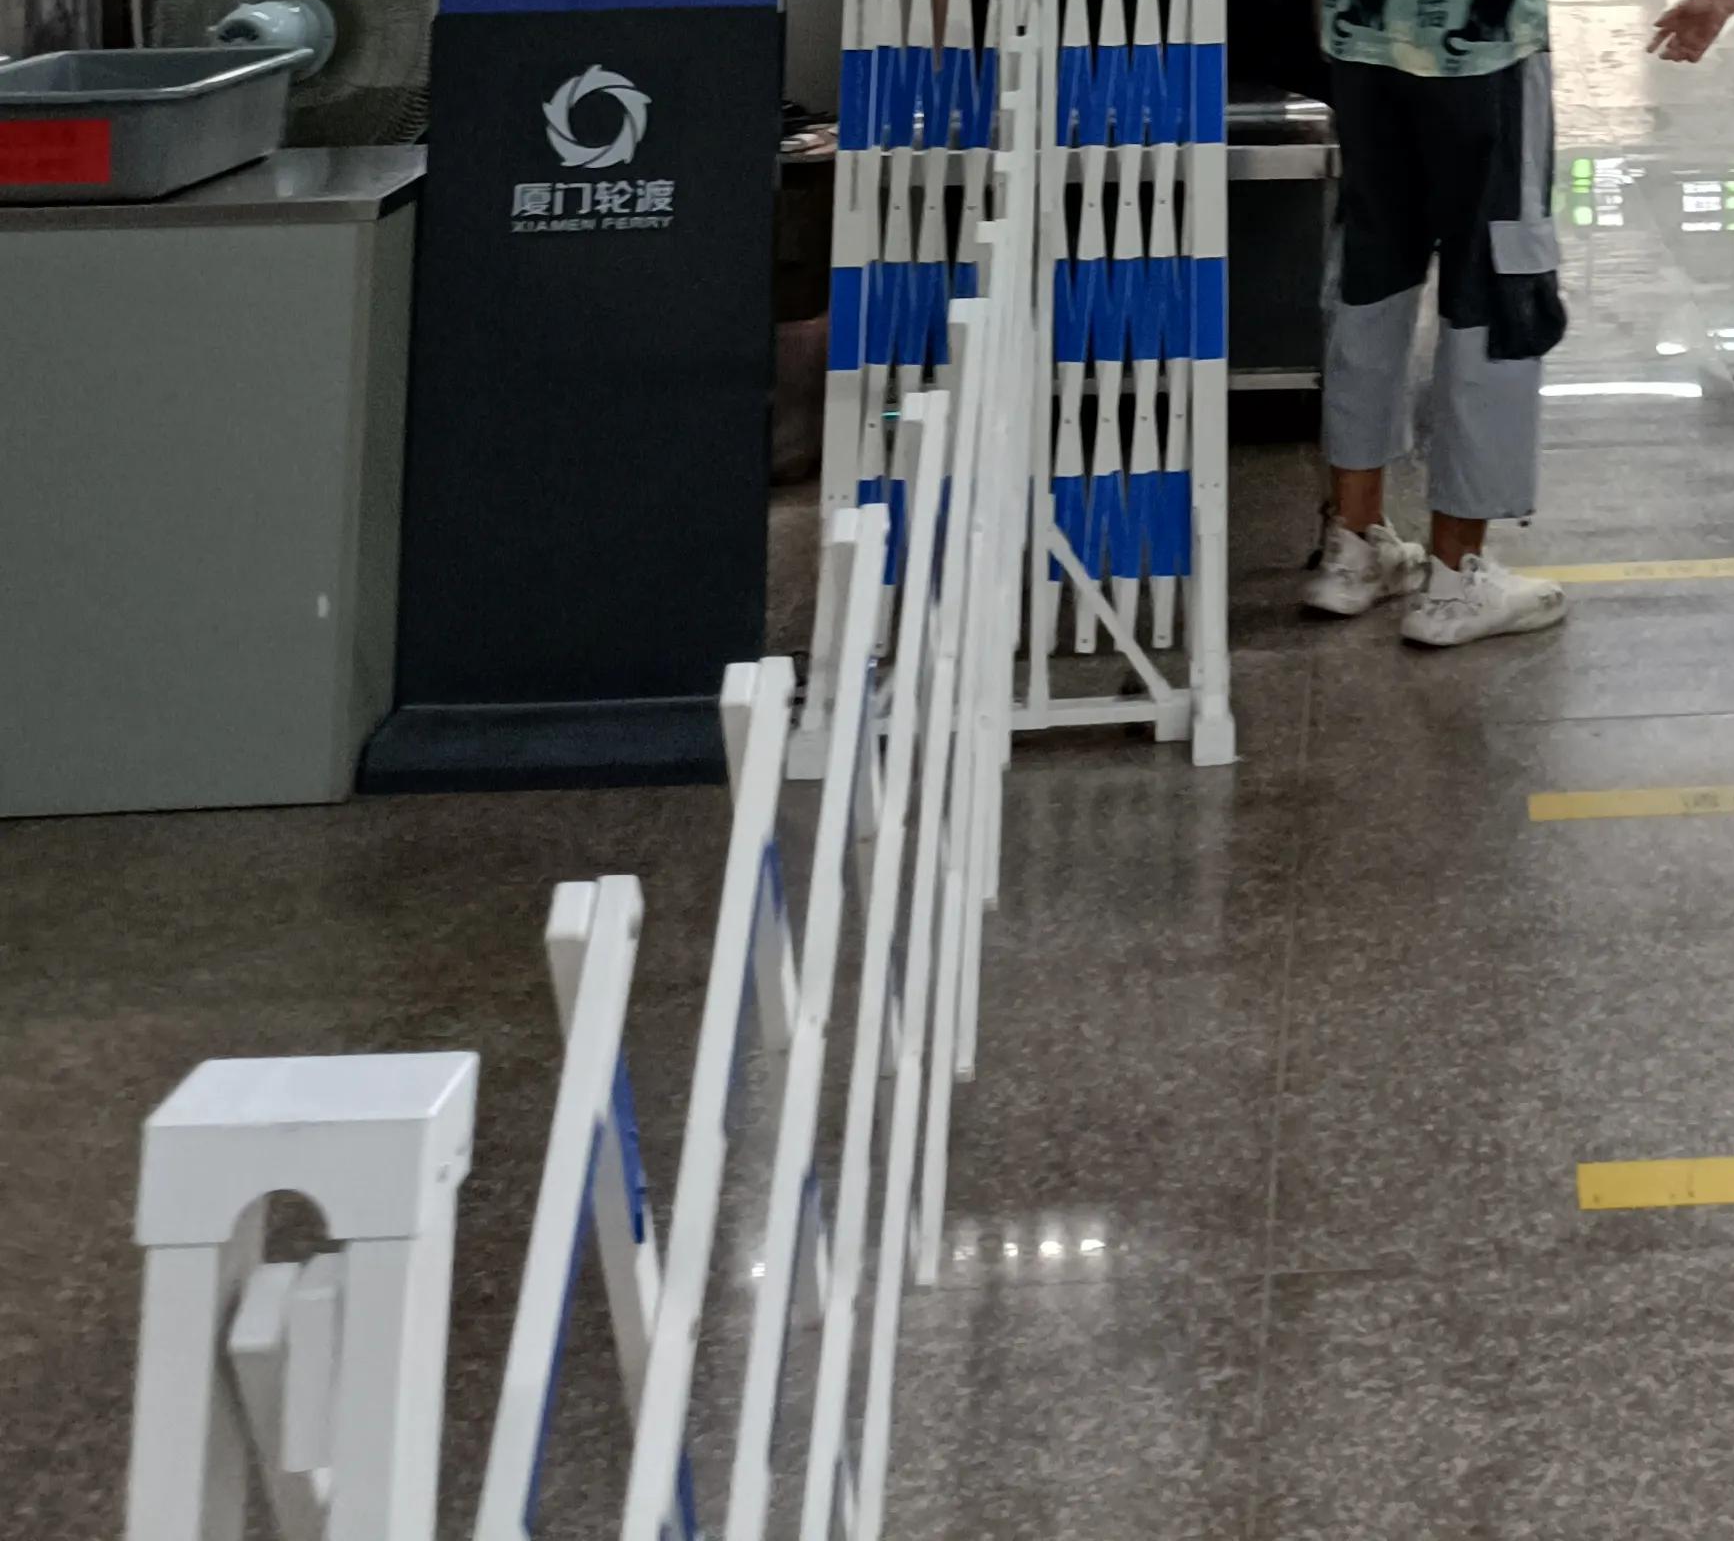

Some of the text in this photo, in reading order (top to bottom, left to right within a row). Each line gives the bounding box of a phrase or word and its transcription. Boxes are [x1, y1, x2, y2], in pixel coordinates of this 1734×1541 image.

[511, 179, 675, 217] 厦门轮渡
[511, 216, 674, 232] XIAMEN FERRY
